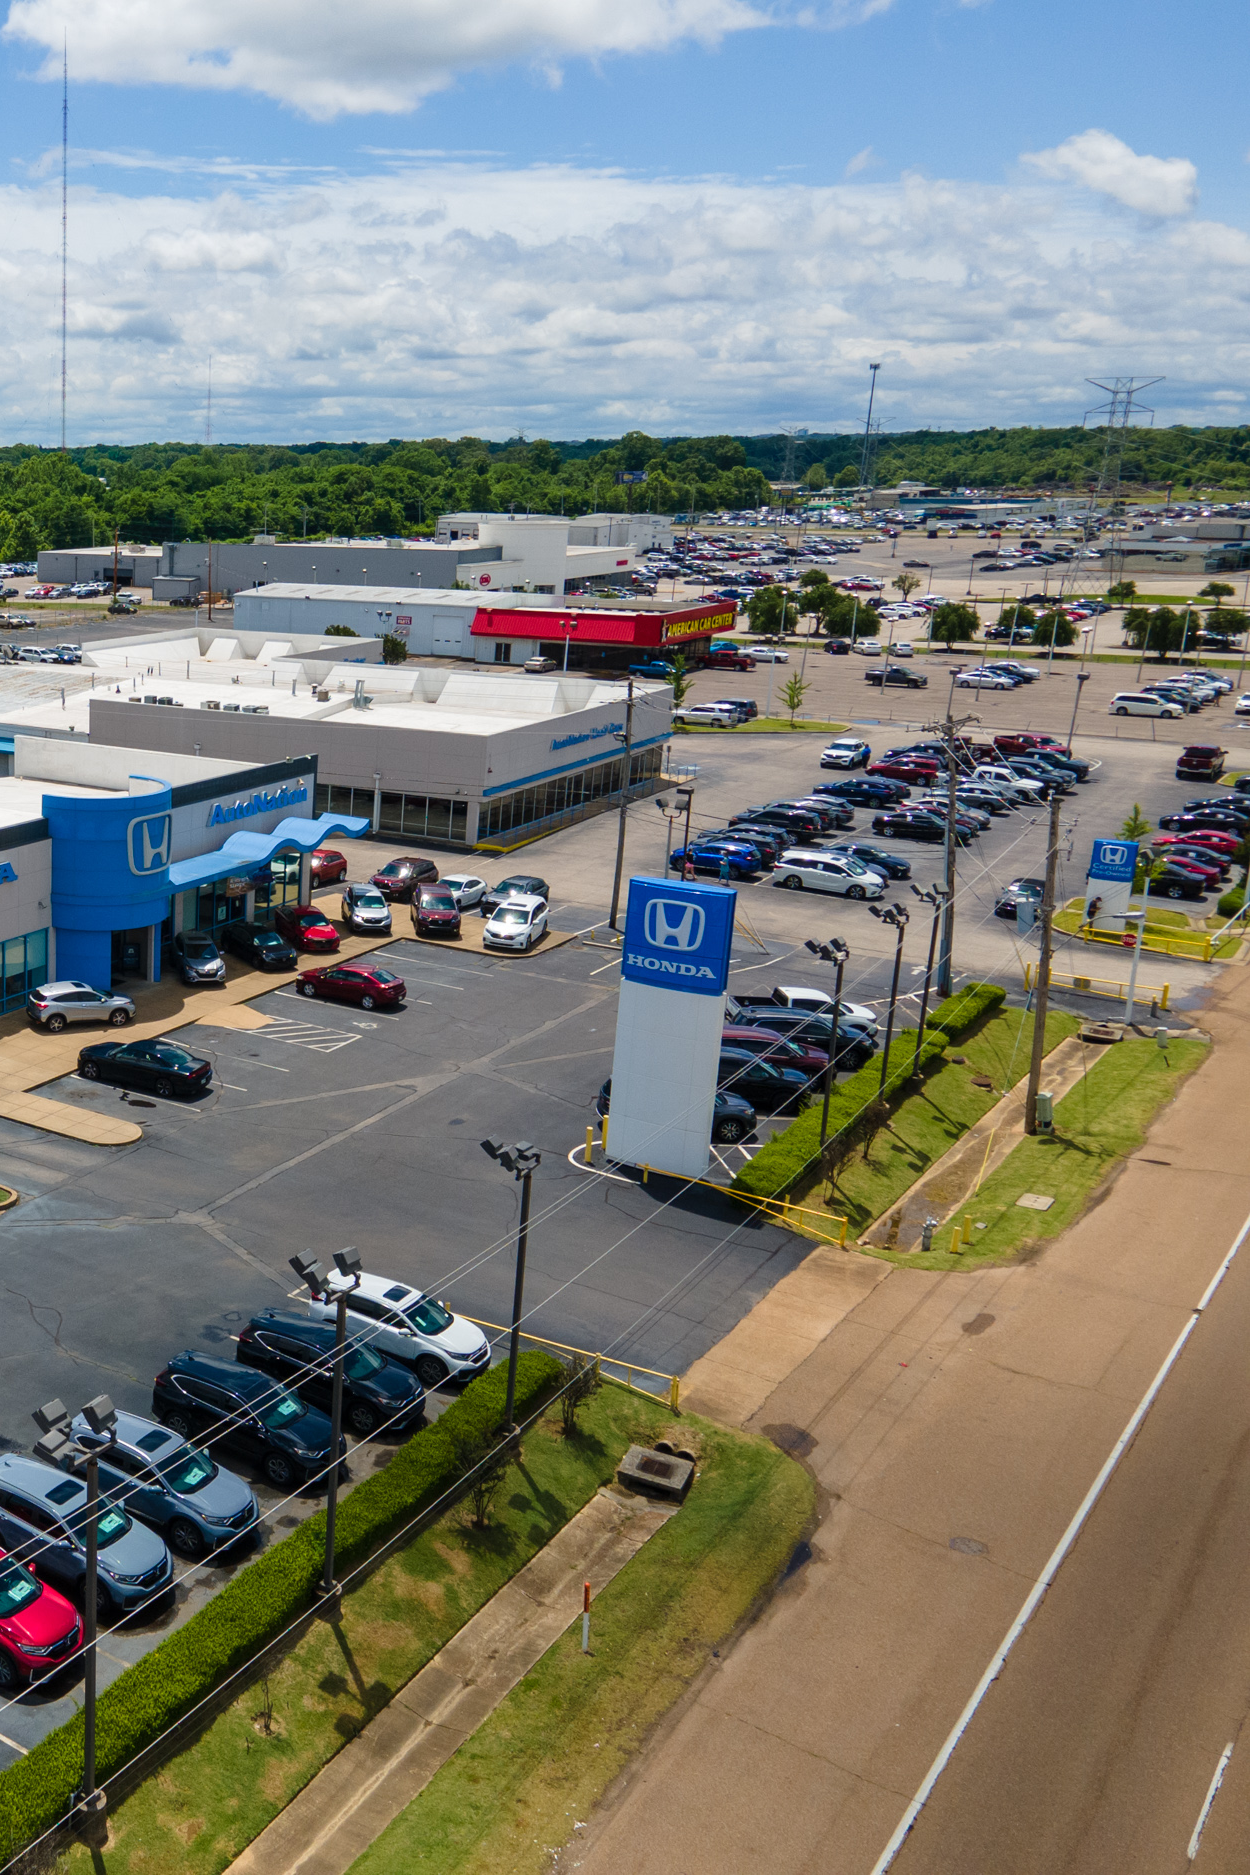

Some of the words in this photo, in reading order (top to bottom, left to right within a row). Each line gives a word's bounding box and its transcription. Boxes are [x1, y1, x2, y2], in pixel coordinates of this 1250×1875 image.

[667, 619, 699, 637] AMERICAN
[699, 617, 711, 631] CAR
[711, 612, 733, 629] CENTER
[206, 785, 308, 827] AutoNation
[1091, 868, 1131, 877] Pre-Owned
[1092, 863, 1132, 872] Certified
[626, 953, 717, 979] HONDA
